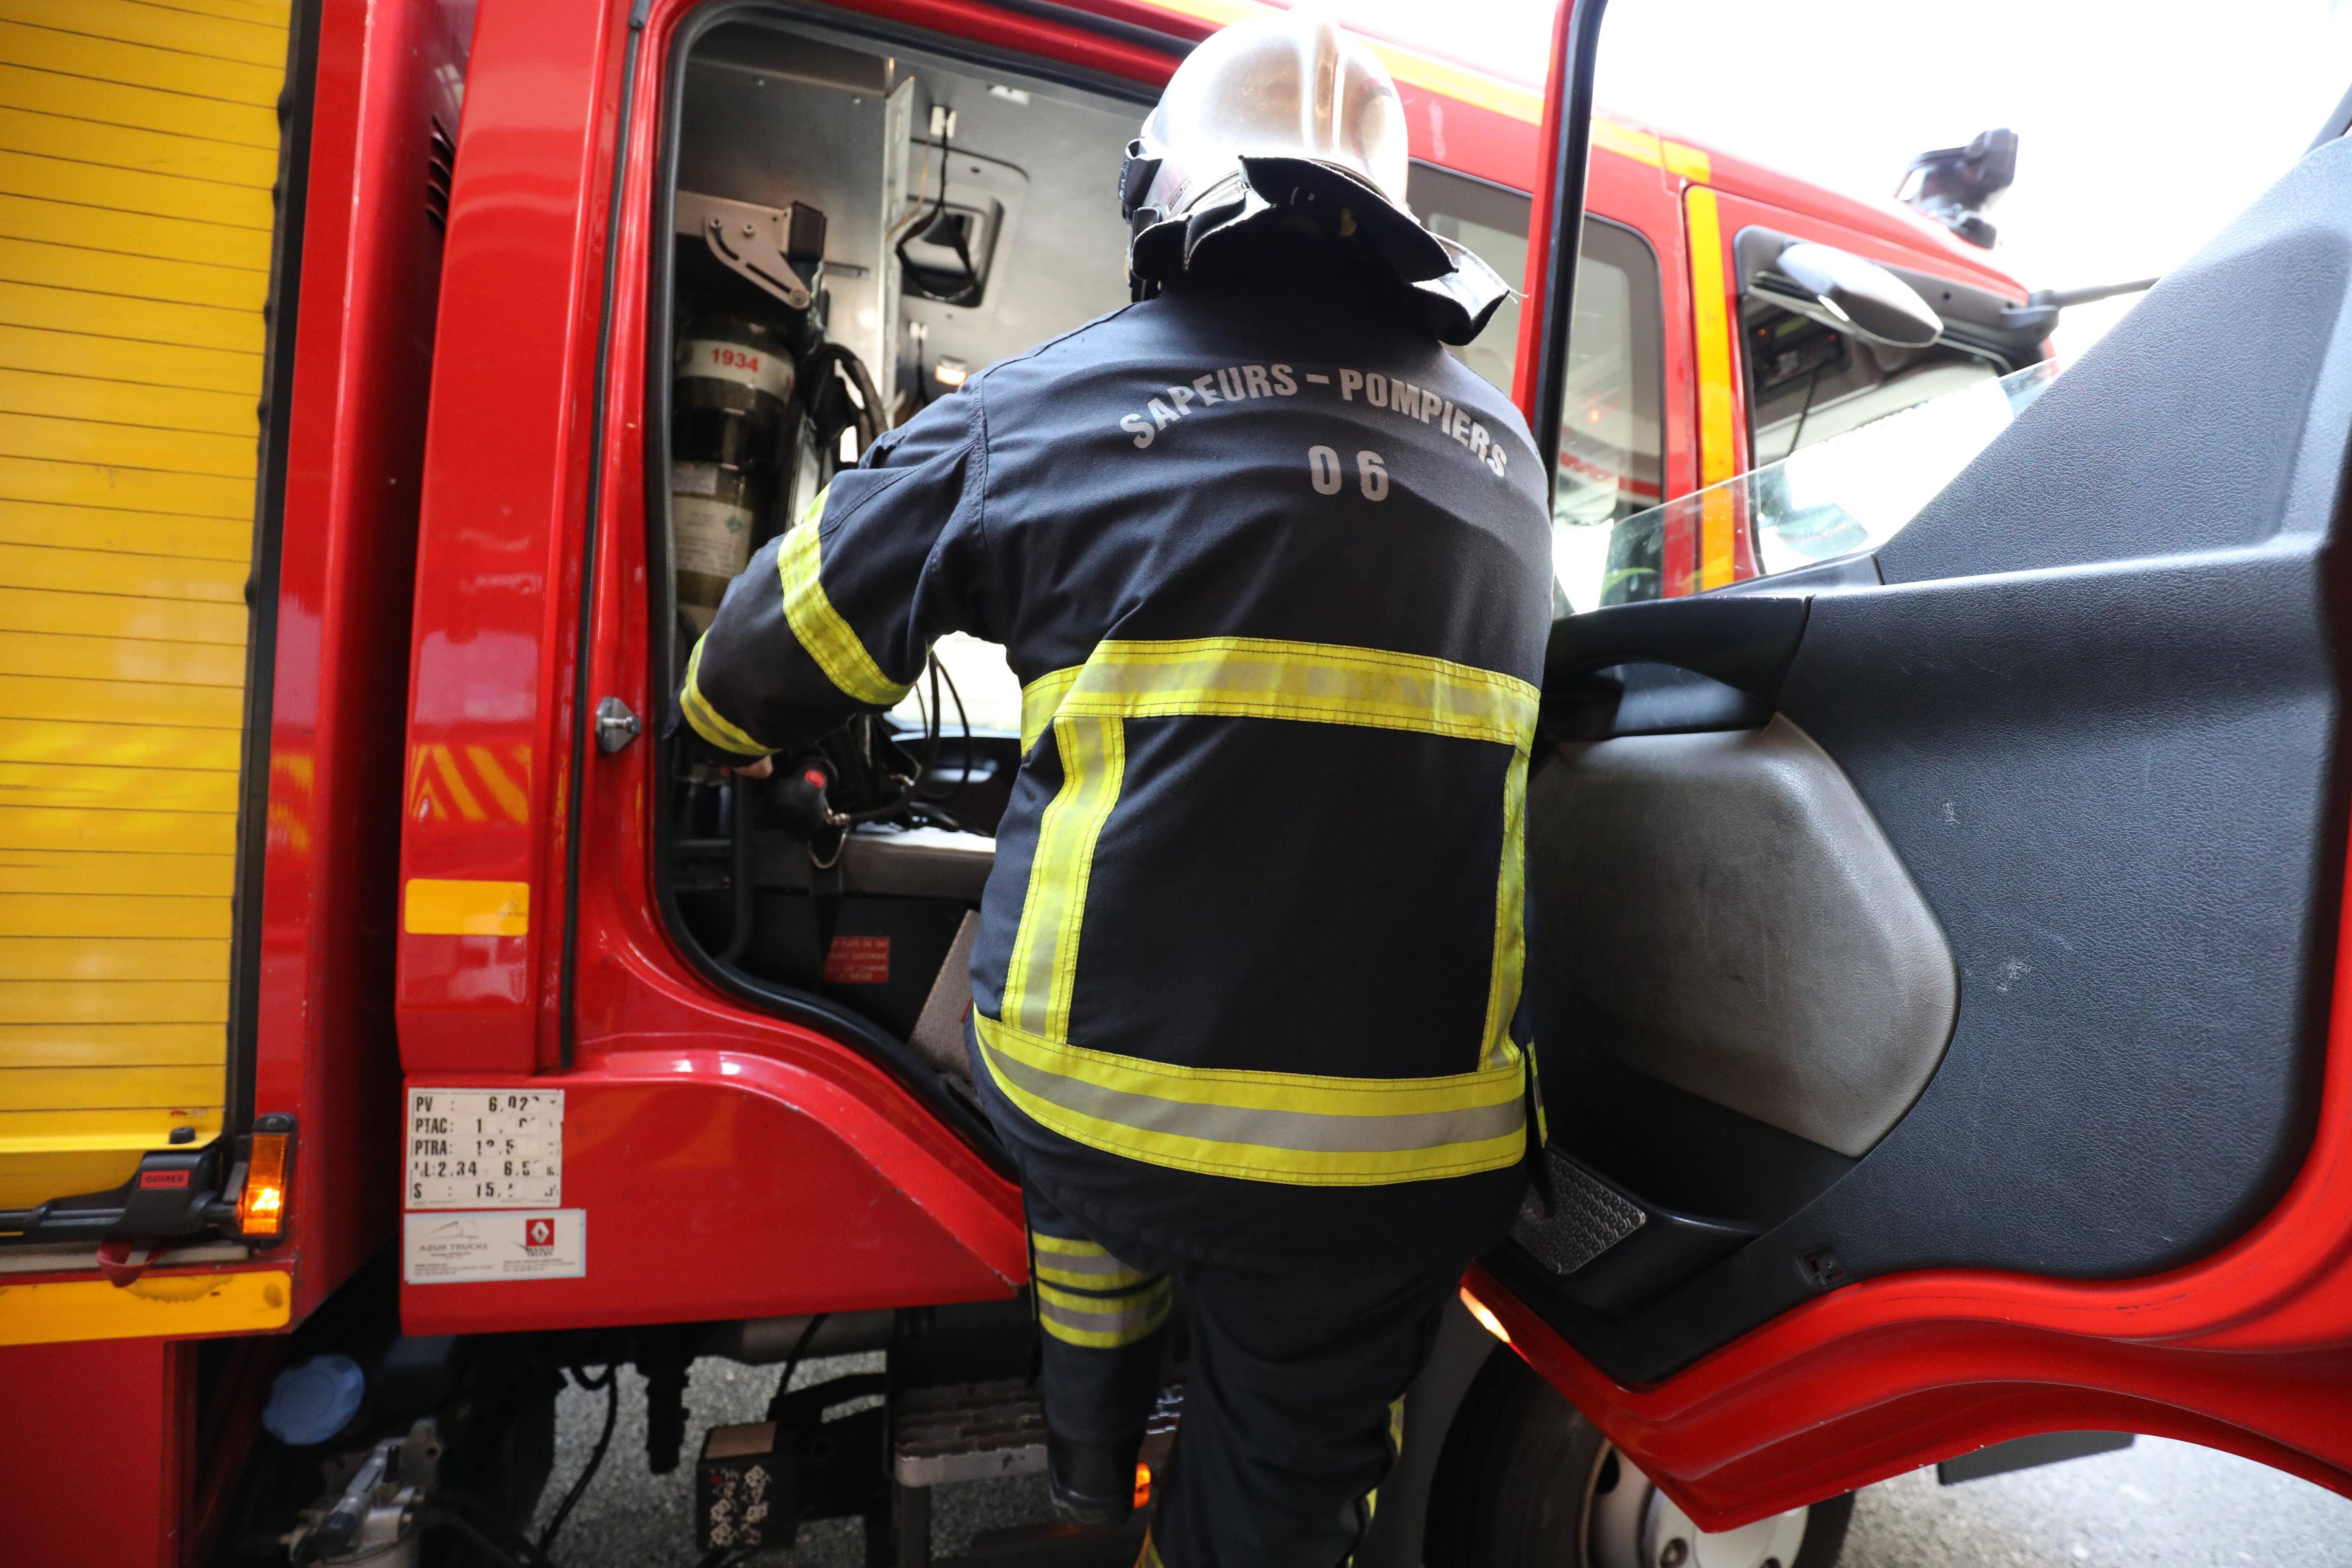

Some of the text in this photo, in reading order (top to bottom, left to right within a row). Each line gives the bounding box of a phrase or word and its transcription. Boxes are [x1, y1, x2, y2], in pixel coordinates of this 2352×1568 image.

[712, 348, 758, 372] 1934
[1120, 364, 1297, 449] SAPEURS
[1339, 368, 1508, 478] POMPIERS
[416, 1096, 433, 1112] PV
